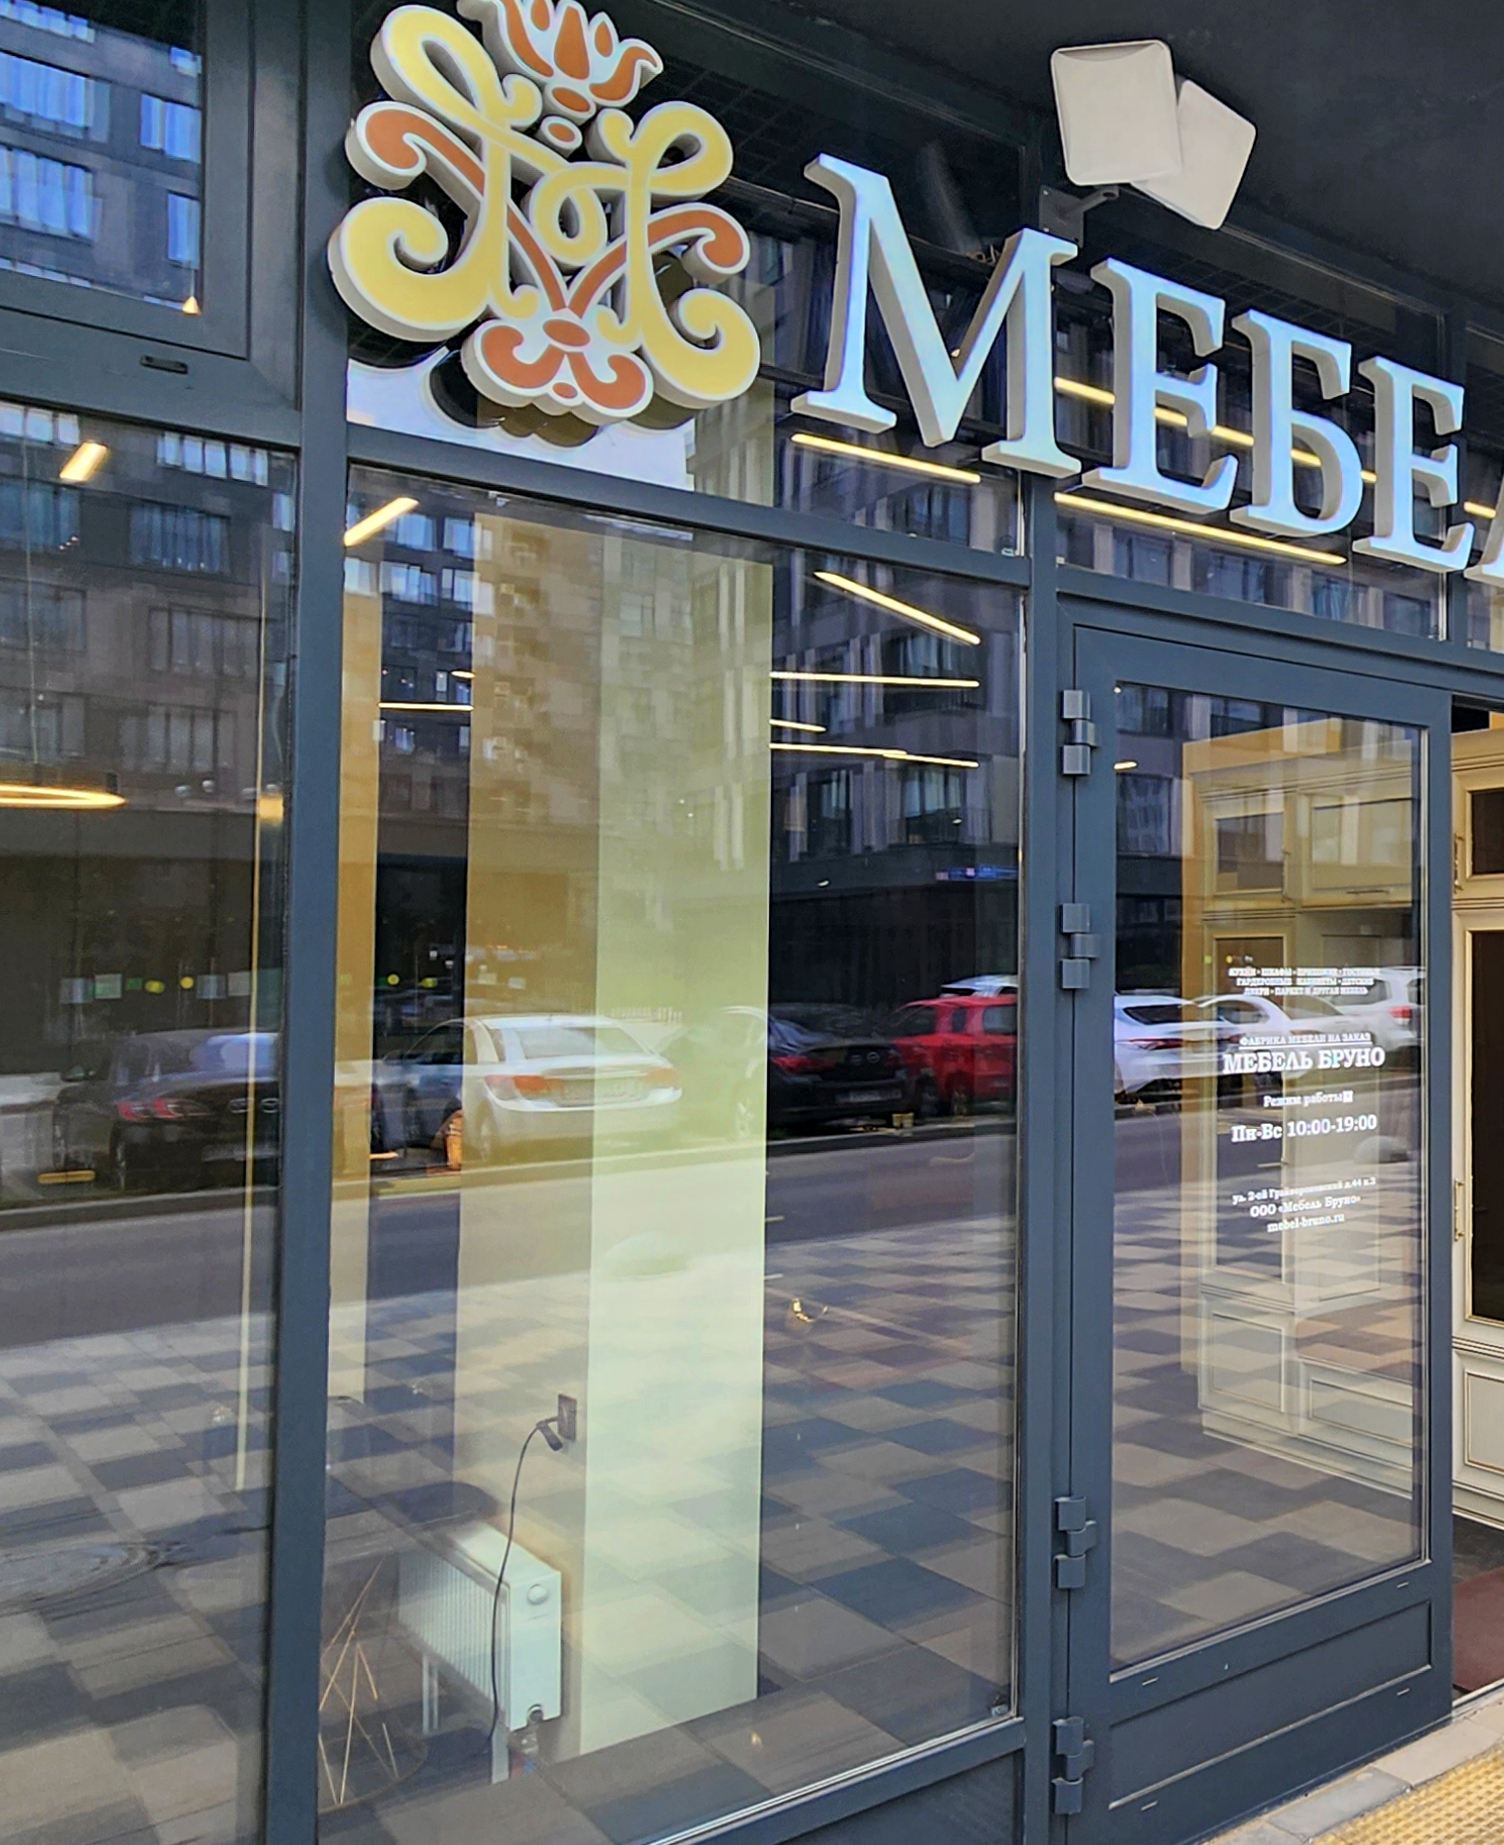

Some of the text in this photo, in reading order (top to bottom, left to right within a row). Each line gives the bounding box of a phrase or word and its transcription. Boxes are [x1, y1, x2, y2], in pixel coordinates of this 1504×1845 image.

[1239, 1035, 1287, 1046] ФАБРИКА
[1328, 1033, 1341, 1043] НА
[1342, 1032, 1371, 1043] ЗАКАЗ
[1222, 1047, 1386, 1074] МЕБЕЛЬ БРУНО
[1263, 1095, 1302, 1107] Режим
[1231, 1114, 1377, 1142] Пн-Вс 10:00-19:00
[1250, 1204, 1277, 1218] ООО
[1267, 1213, 1345, 1233] mebel-bruno.ru
